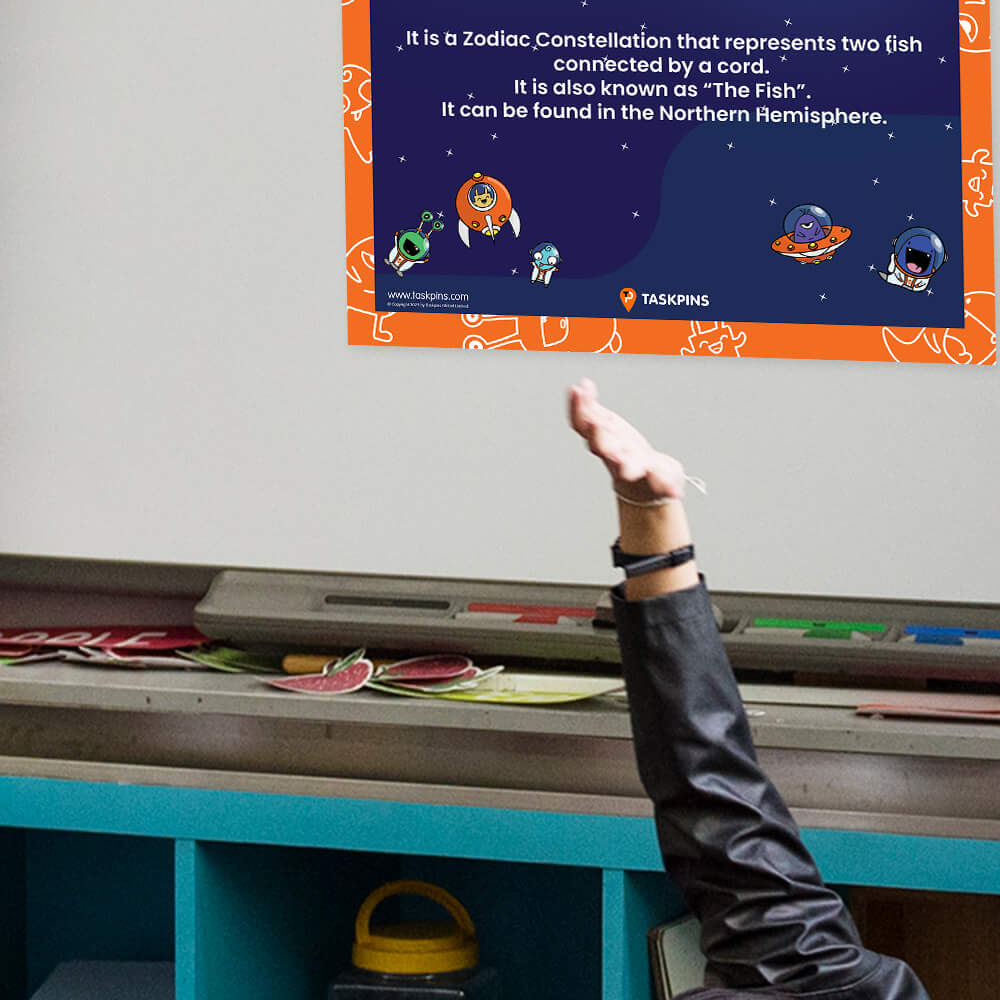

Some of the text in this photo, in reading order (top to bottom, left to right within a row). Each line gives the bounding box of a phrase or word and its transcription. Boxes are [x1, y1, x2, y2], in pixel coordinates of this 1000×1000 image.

[407, 29, 923, 55] It is a Zodiac Constellation that represents two fish
[553, 57, 770, 79] connected by a cord.
[514, 78, 811, 100] It is also known as “The Fish”.
[442, 101, 888, 128] It can be found in the Northern Hemisphere.
[387, 291, 469, 302] www.taskpins.com
[641, 293, 710, 307] TASKPINS
